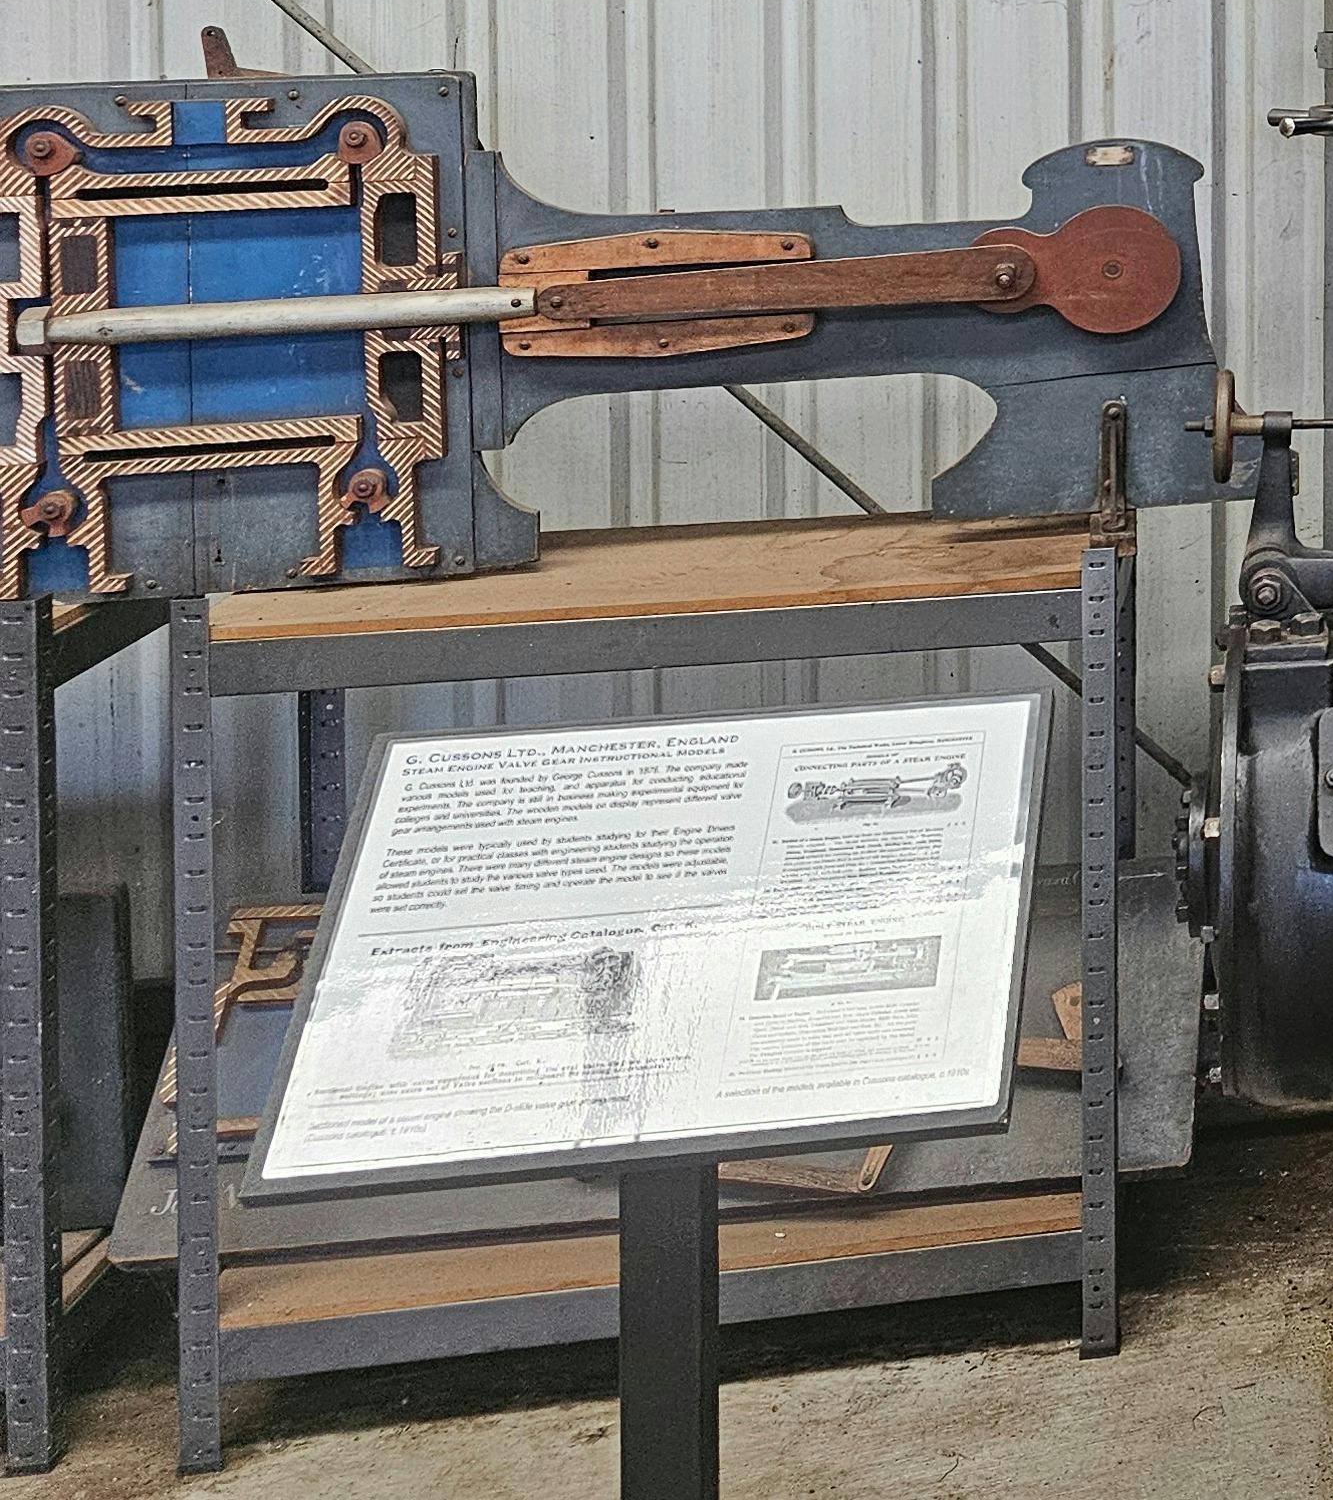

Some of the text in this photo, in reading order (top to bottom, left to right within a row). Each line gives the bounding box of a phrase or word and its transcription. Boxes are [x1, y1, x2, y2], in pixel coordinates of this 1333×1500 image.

[402, 748, 725, 776] STEAM ENGINE VALVE GEAR INSTRUCTIONAL MODELS
[406, 735, 739, 765] G. CUSSONS LTD., MANCHESTER, ENGLAND
[439, 942, 474, 951] from
